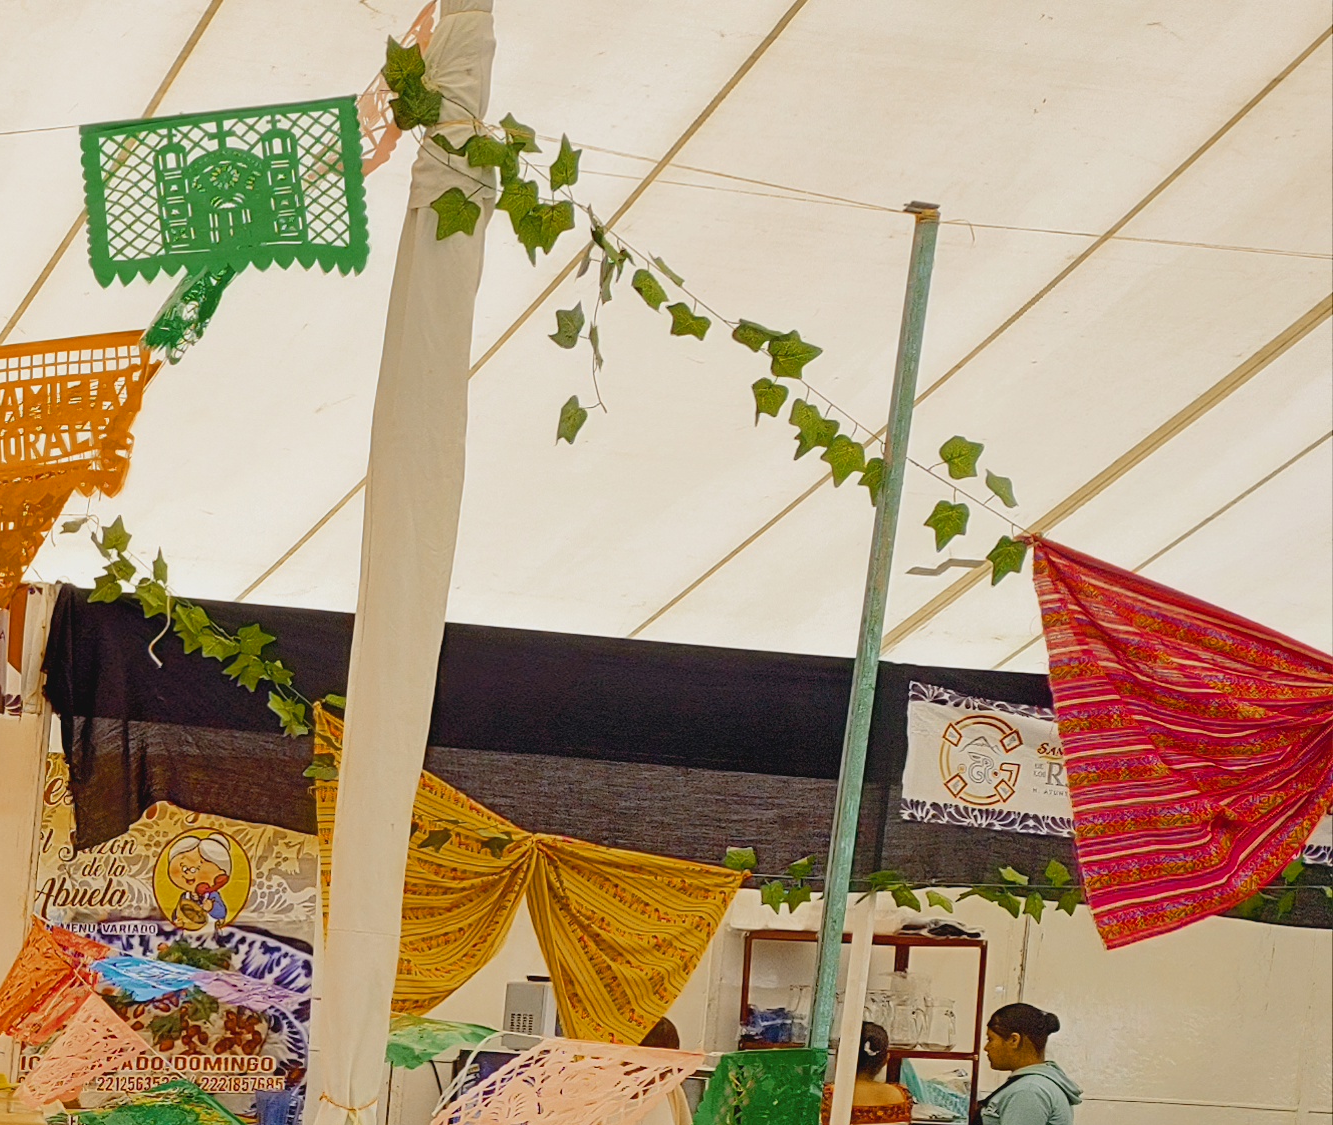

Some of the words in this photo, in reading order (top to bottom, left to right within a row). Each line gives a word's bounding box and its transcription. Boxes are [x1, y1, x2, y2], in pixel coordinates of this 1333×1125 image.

[81, 857, 105, 877] de
[106, 857, 129, 877] la
[34, 877, 132, 921] Abuela
[102, 923, 158, 935] VARIADO
[174, 1055, 275, 1073] DOMINGO
